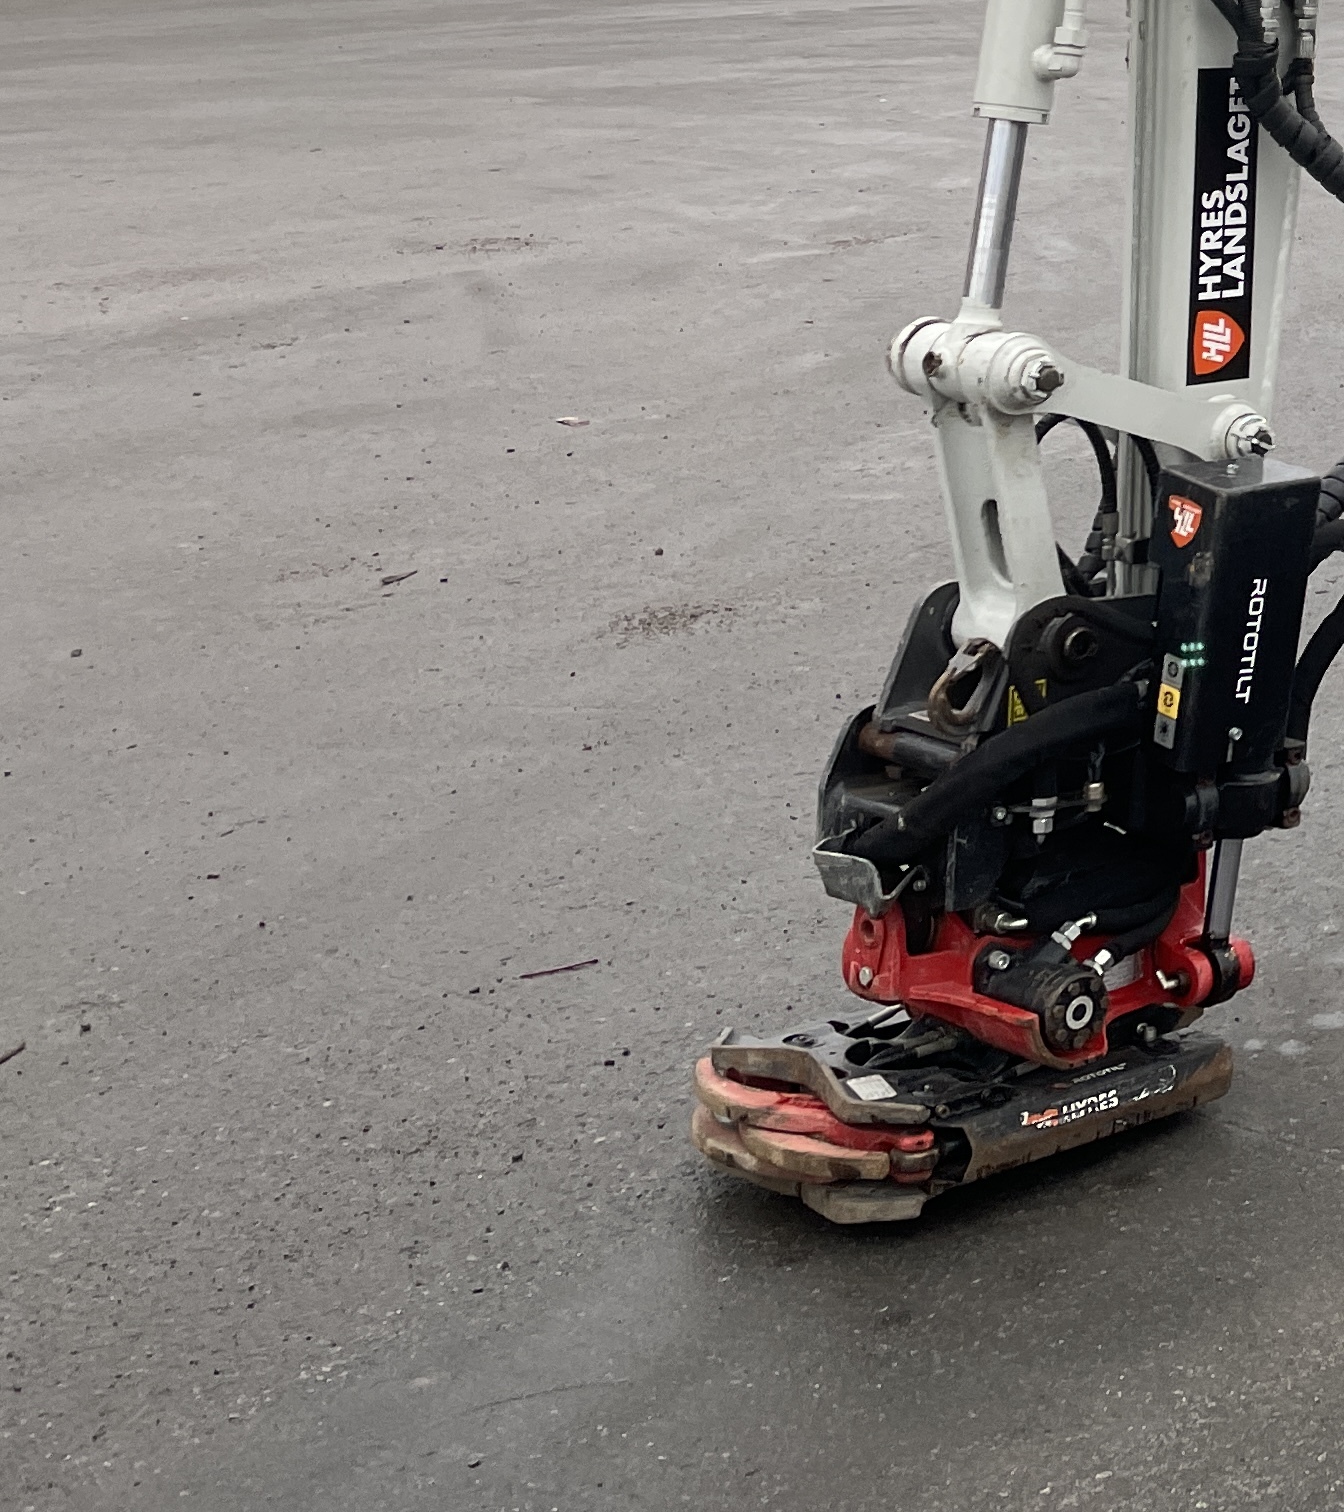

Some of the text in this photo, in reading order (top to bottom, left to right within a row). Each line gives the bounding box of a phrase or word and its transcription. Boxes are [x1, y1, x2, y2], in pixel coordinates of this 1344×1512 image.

[1198, 189, 1225, 301] HYRES
[1219, 77, 1251, 300] LANDSLAGET
[1235, 578, 1268, 704] ROTOTILT
